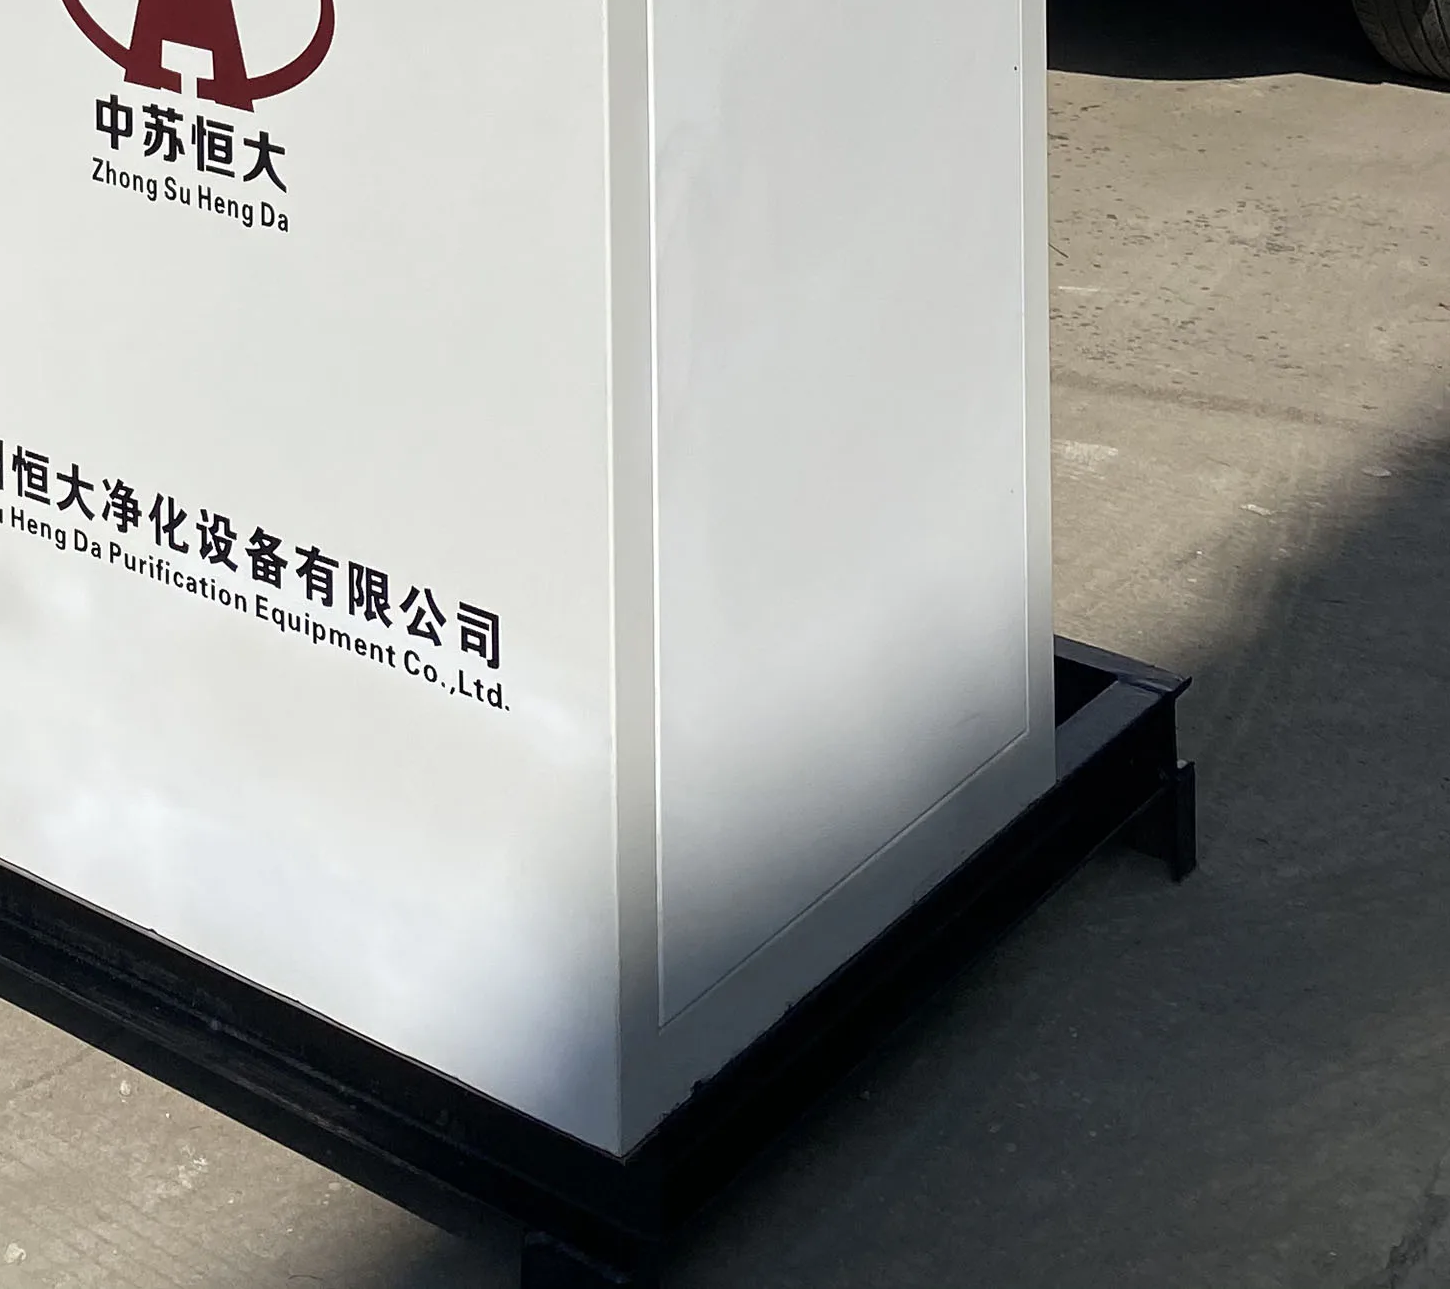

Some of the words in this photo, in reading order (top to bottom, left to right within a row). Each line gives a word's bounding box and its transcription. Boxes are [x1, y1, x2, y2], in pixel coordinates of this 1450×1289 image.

[95, 94, 288, 194] 中苏恒大
[91, 156, 157, 202] Zhong
[164, 177, 191, 206] Su
[198, 185, 254, 228] Heng
[261, 201, 289, 233] Da
[10, 509, 67, 550] Heng
[74, 529, 102, 560] Da
[109, 539, 248, 614] Purification
[255, 595, 397, 669] Equipment
[403, 650, 511, 711] Co.,Ltd.
